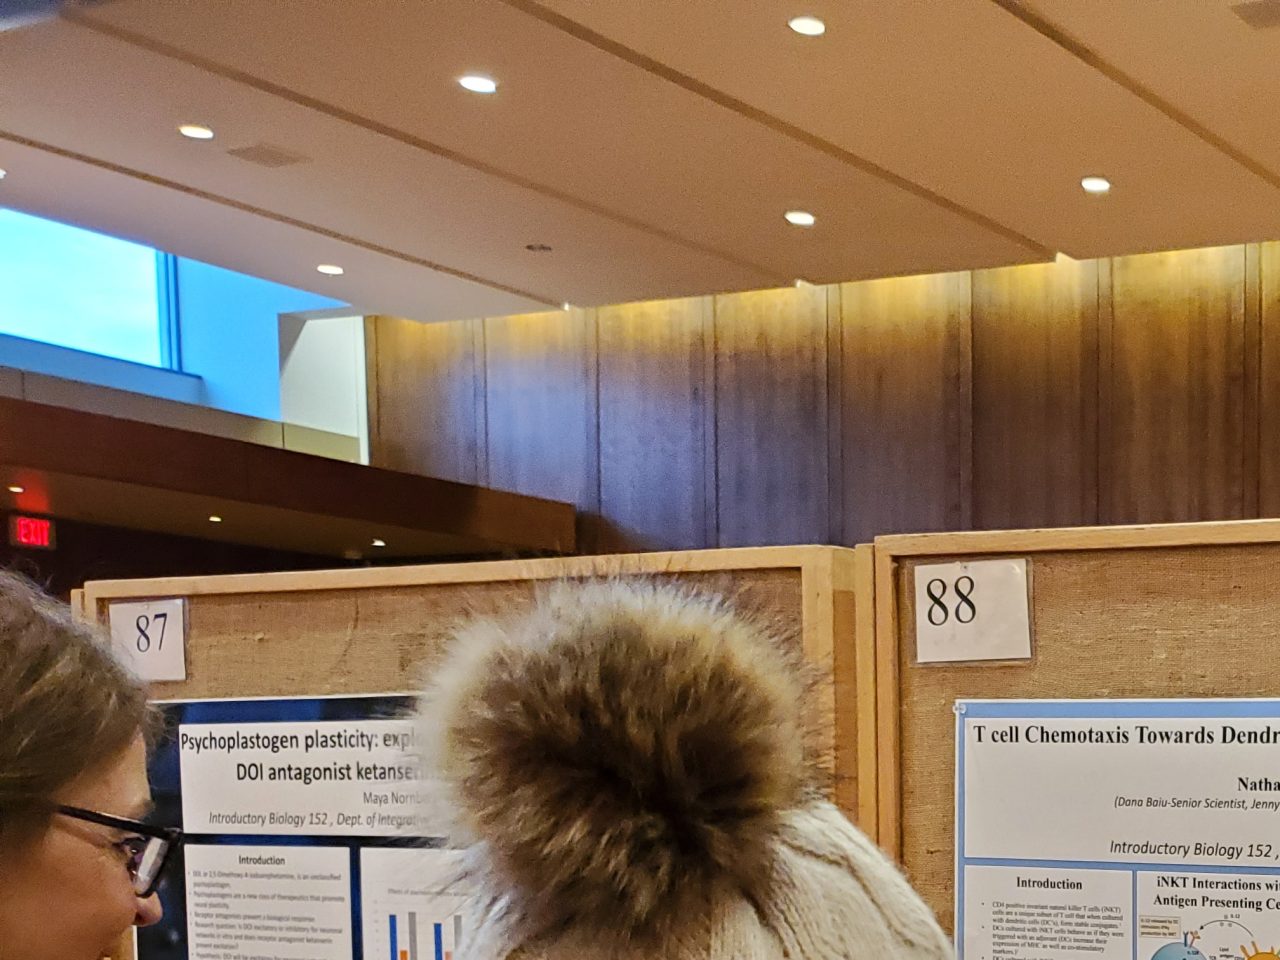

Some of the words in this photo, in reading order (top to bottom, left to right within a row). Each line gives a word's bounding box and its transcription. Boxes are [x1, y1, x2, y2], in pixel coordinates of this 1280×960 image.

[18, 518, 50, 546] EXIT
[926, 576, 976, 626] 88
[135, 612, 168, 652] 87
[181, 732, 299, 754] Psychoplastogen
[304, 729, 378, 753] plasticity:
[973, 725, 986, 742] T
[991, 725, 1019, 742] cell
[1025, 725, 1129, 743] Chemotaxis
[1134, 725, 1214, 744] Towards
[236, 762, 263, 780] DOI
[268, 761, 352, 785] antagonist
[363, 792, 389, 806] Maya
[1114, 796, 1143, 808] (Dana
[1146, 797, 1202, 808] Baiu-Senior
[1203, 798, 1247, 810] Scientist,
[1250, 799, 1280, 811] Jenny
[209, 811, 266, 826] Introductory
[269, 812, 305, 827] Biology
[309, 812, 327, 825] 152
[336, 812, 362, 827] Dept.
[366, 812, 376, 828] of
[1110, 840, 1190, 858] Introductory
[1193, 842, 1243, 860] Biology
[1246, 843, 1272, 857] 152
[238, 855, 286, 866] Introduction
[1016, 876, 1082, 889] Introduction
[1157, 876, 1189, 888] iNKT
[1192, 877, 1261, 890] Interactions
[1153, 894, 1197, 908] Antigen
[1201, 895, 1262, 912] Presenting
